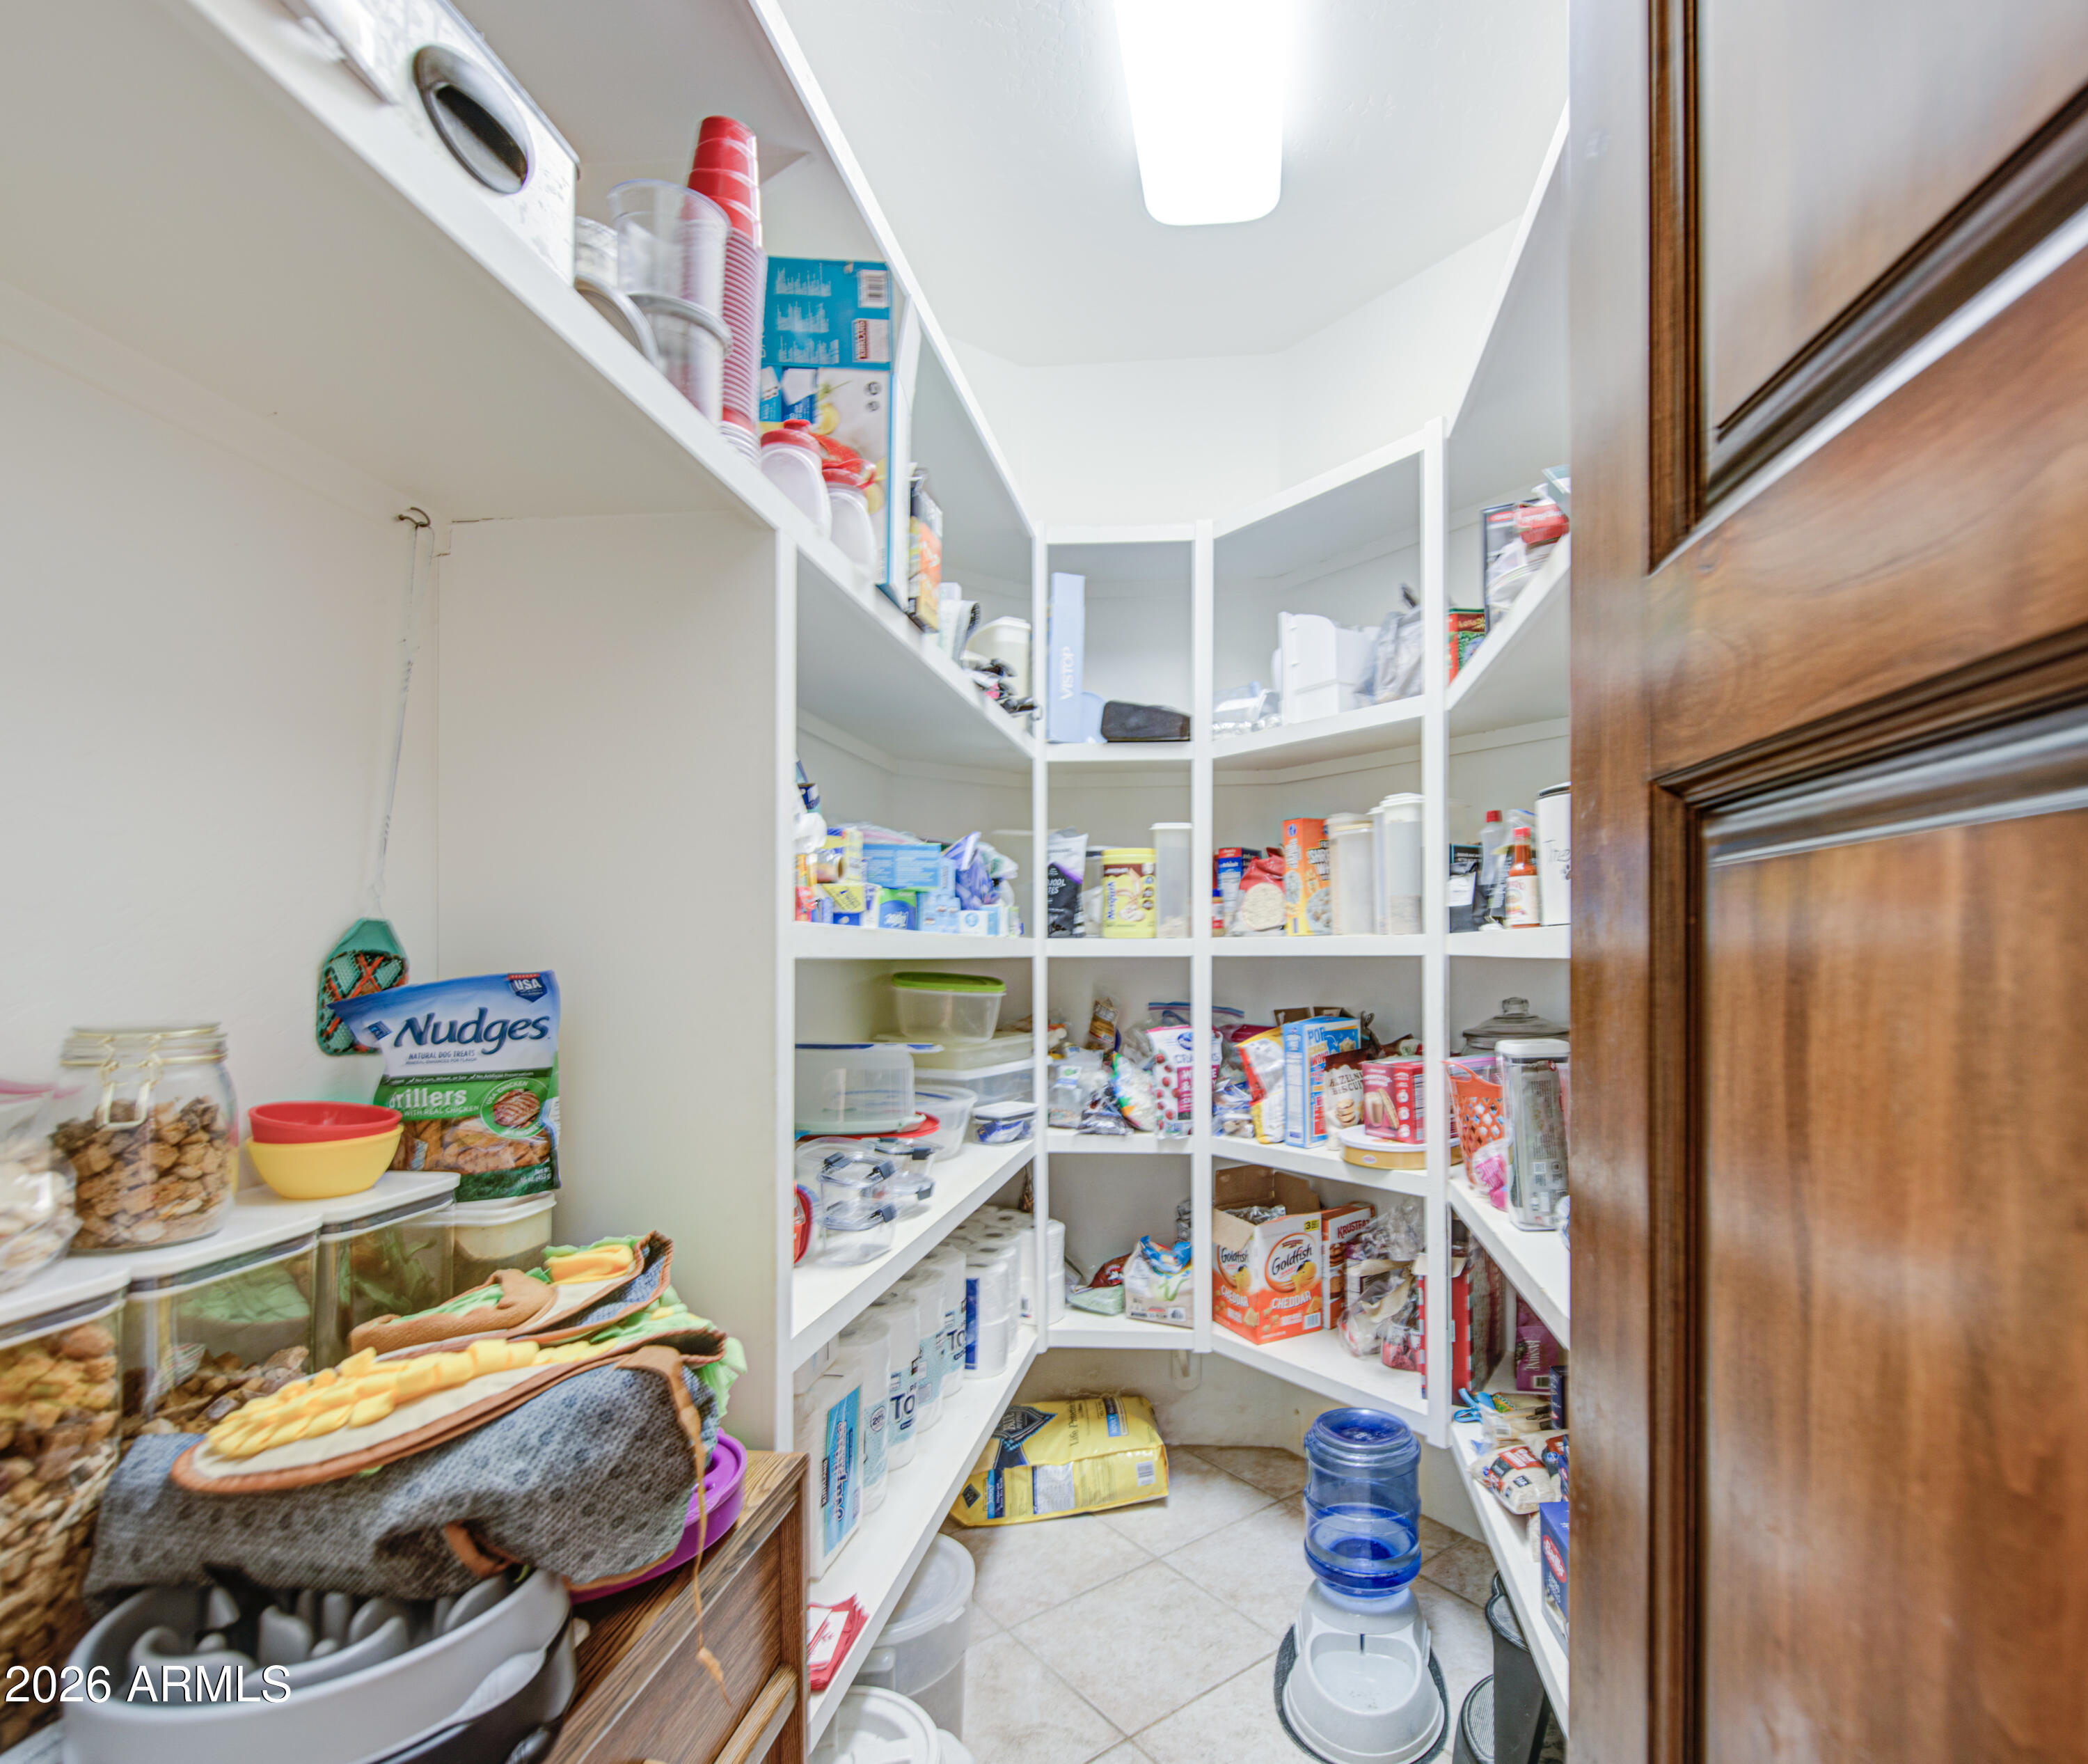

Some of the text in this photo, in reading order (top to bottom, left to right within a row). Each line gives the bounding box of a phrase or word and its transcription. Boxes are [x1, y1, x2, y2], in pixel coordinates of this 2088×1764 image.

[1058, 645, 1075, 701] VISTOP
[514, 978, 542, 991] USA
[393, 1007, 551, 1055] Nudges
[498, 1080, 528, 1093] CHICKEN
[445, 1105, 480, 1115] CHICKEN
[1304, 1222, 1311, 1230] 3
[1272, 1243, 1313, 1275] Goldfish
[1221, 1284, 1249, 1307] CHEDDAR
[1272, 1290, 1312, 1309] CHEDDAR
[1002, 1412, 1015, 1431] BLUE
[1109, 1416, 1118, 1434] ADULT
[1069, 1431, 1079, 1447] Life
[1543, 1538, 1566, 1577] Barilla
